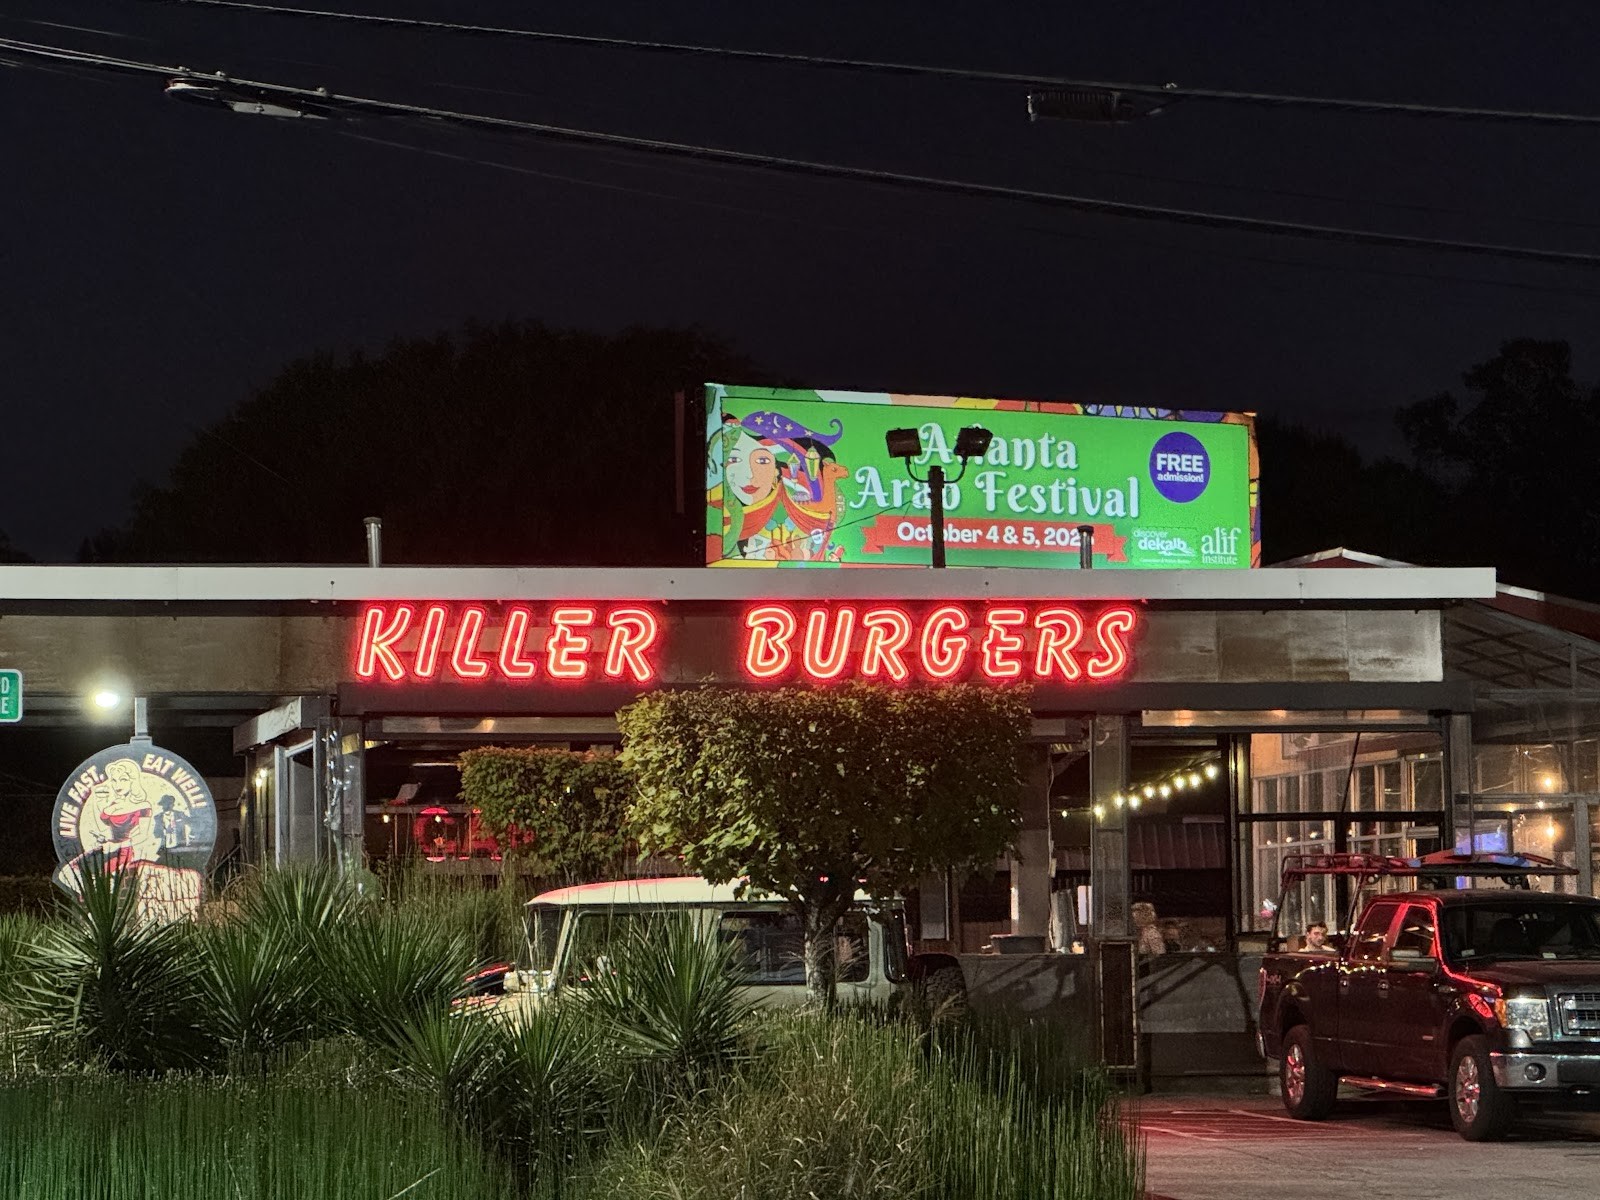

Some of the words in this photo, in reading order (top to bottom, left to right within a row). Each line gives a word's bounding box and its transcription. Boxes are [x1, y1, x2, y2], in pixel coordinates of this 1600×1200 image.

[914, 422, 1079, 471] Aanta
[1156, 453, 1204, 473] FREE
[1157, 472, 1204, 483] admission!
[974, 470, 1140, 518] Festival
[897, 521, 983, 544] Octber
[985, 525, 1000, 543] 4
[1002, 526, 1019, 544] &
[1022, 527, 1041, 548] 5,
[1043, 527, 1095, 548] 202
[1138, 537, 1188, 551] dekalb
[1201, 527, 1242, 555] alif
[1202, 555, 1238, 565] institute
[356, 606, 658, 682] KILLER
[744, 606, 1138, 681] BURGERS
[59, 802, 80, 838] LIVE
[141, 753, 175, 776] EAT
[170, 767, 207, 809] WELL!
